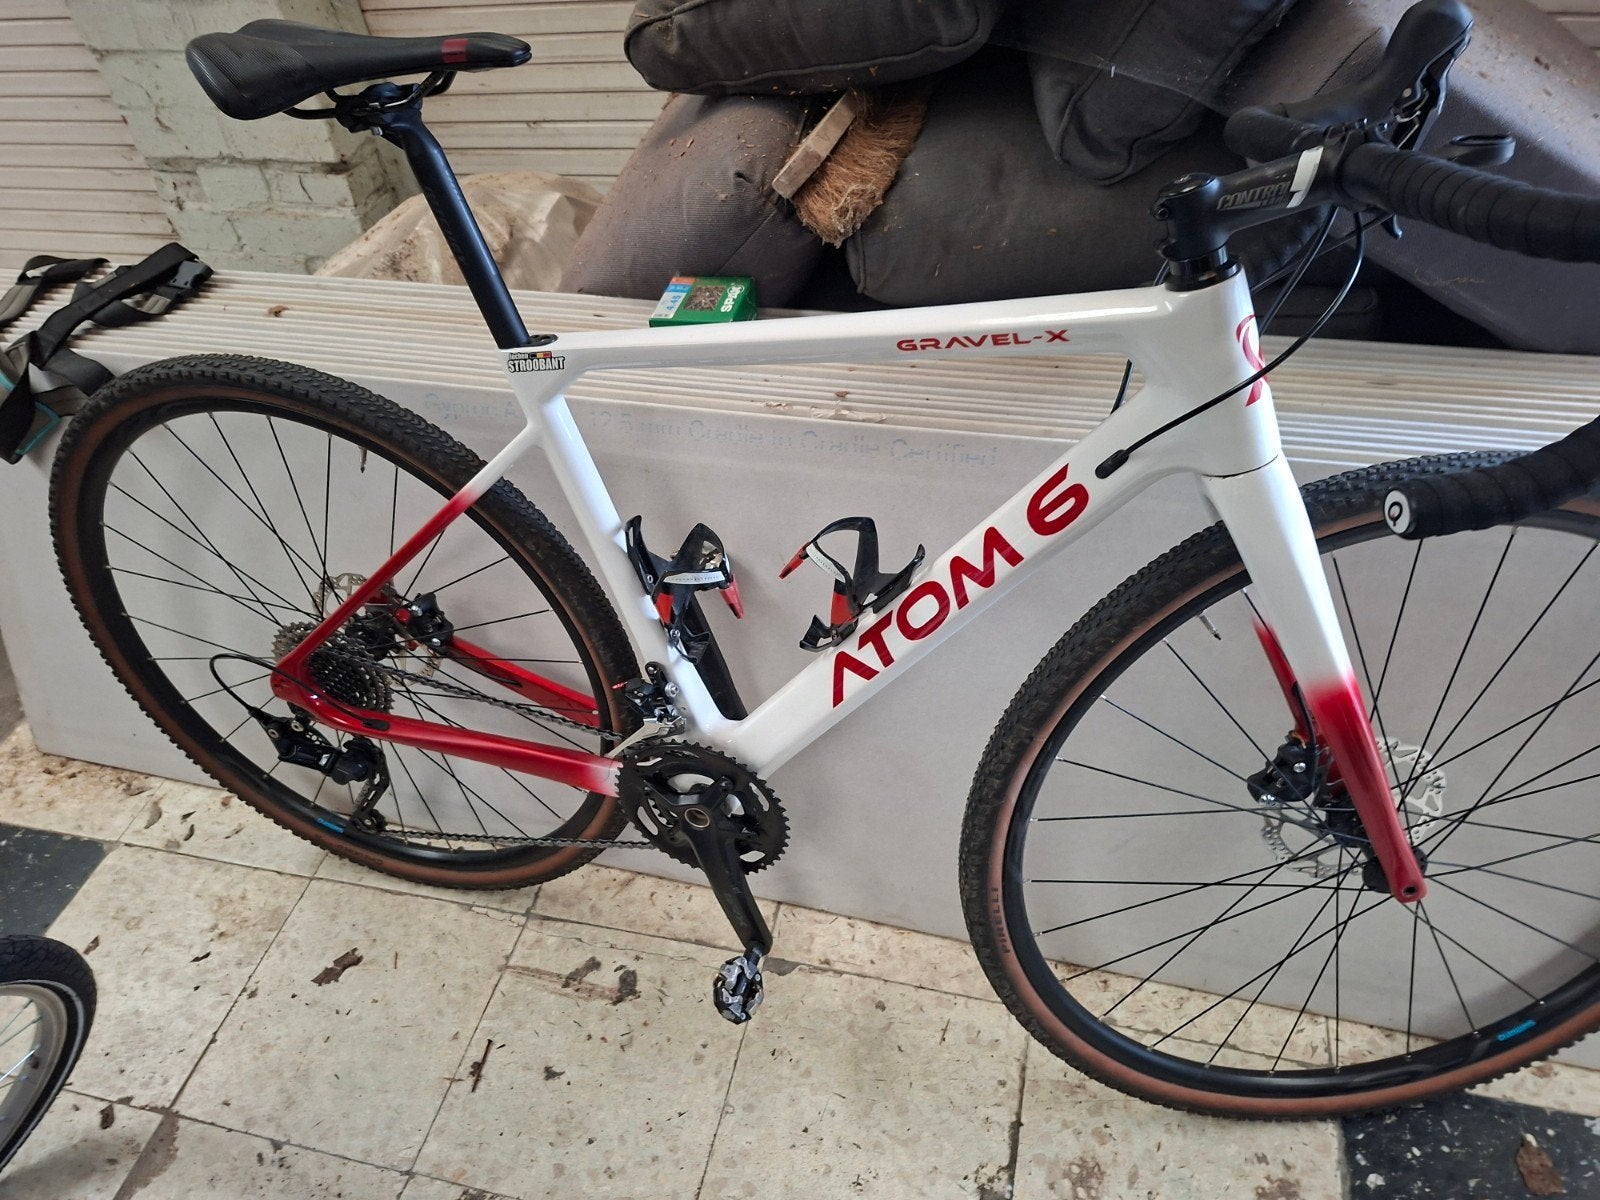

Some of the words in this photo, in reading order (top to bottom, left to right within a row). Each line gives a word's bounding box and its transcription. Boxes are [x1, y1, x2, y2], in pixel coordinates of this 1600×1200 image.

[896, 329, 1071, 351] GRAVEL-X
[508, 356, 565, 373] STROOBANT
[832, 526, 1025, 709] ATOM
[1026, 462, 1089, 536] 6
